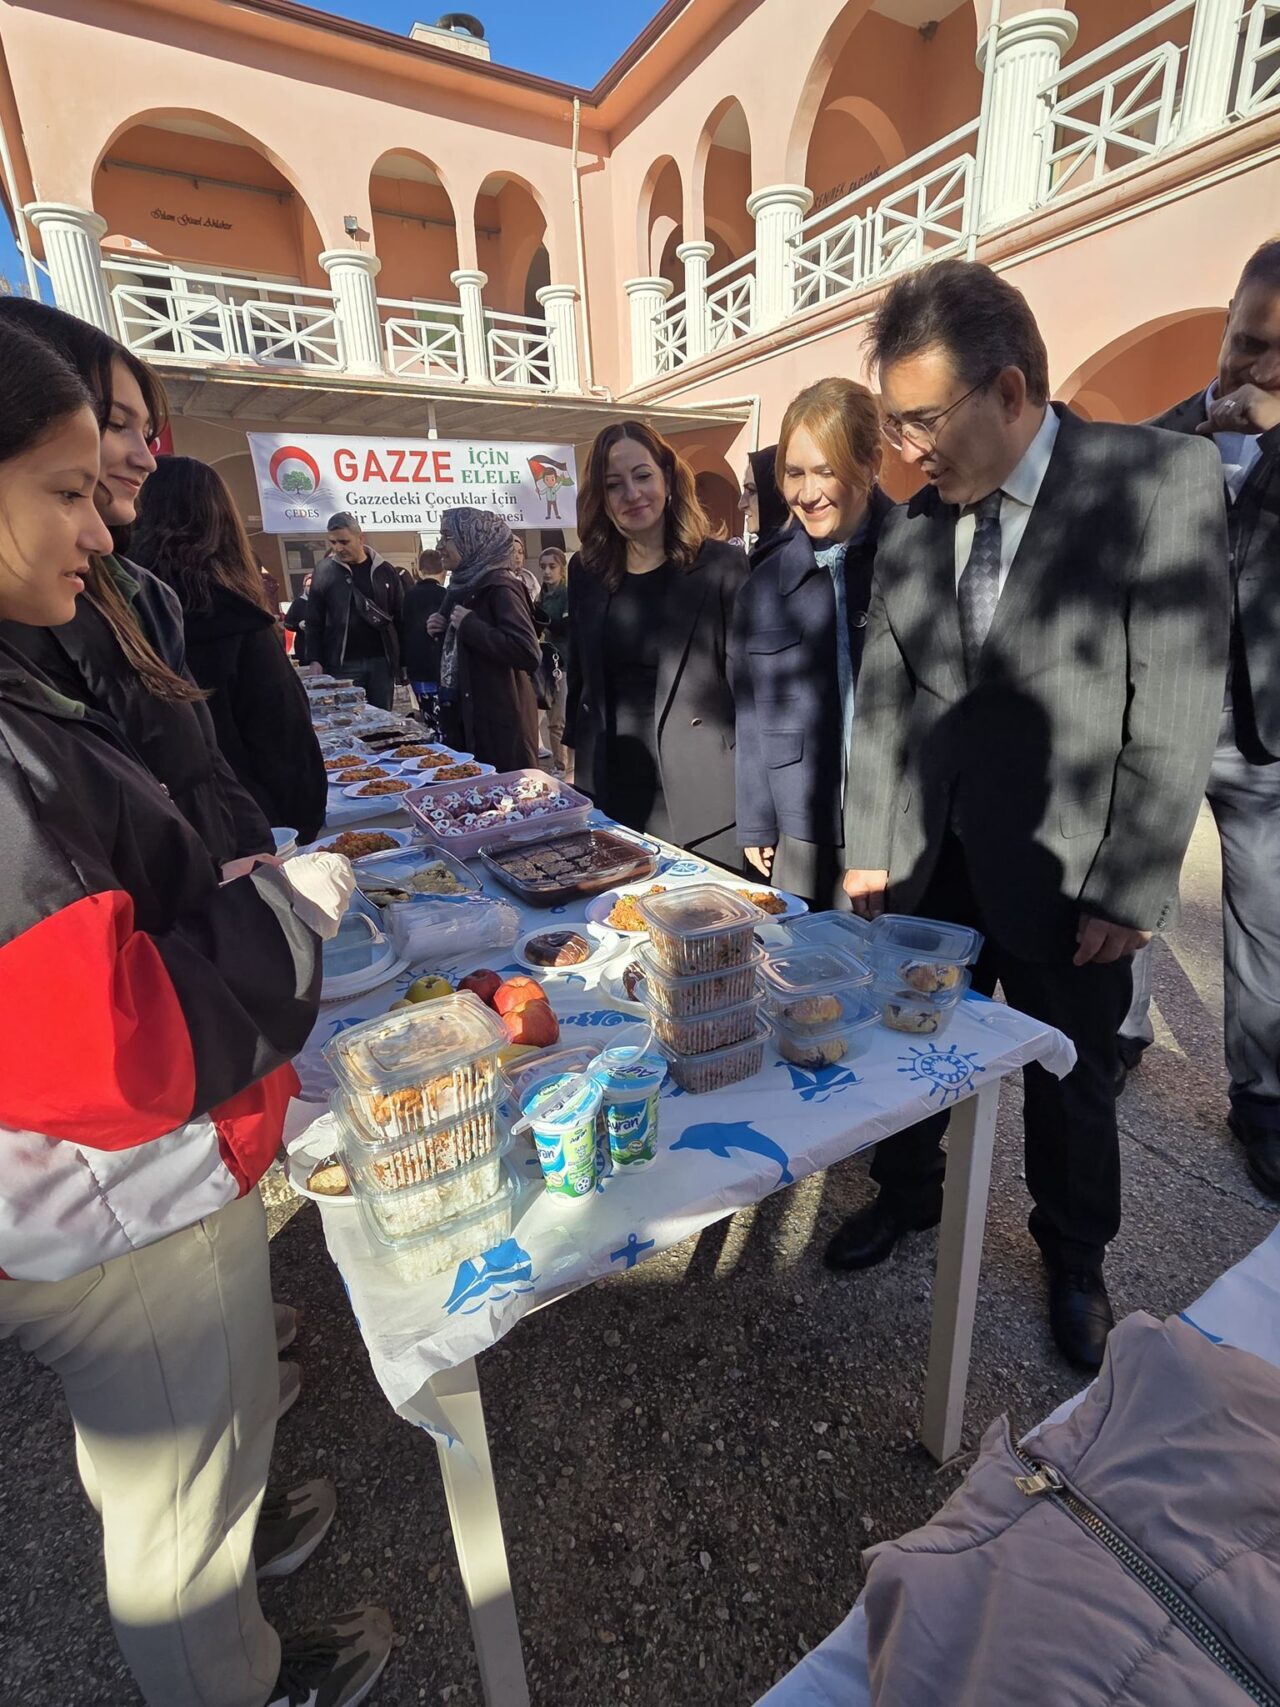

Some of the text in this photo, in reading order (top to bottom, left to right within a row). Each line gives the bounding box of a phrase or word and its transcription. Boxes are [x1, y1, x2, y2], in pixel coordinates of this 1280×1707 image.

[469, 447, 509, 468] İÇİN
[333, 448, 454, 483] GAZZE
[461, 470, 521, 484] ELELE
[345, 491, 421, 505] Gazzedeki
[492, 489, 517, 508] İçin
[284, 509, 320, 520] ÇEDES
[353, 510, 367, 524] ir
[371, 510, 422, 524] Lokma
[538, 1149, 555, 1159] ran
